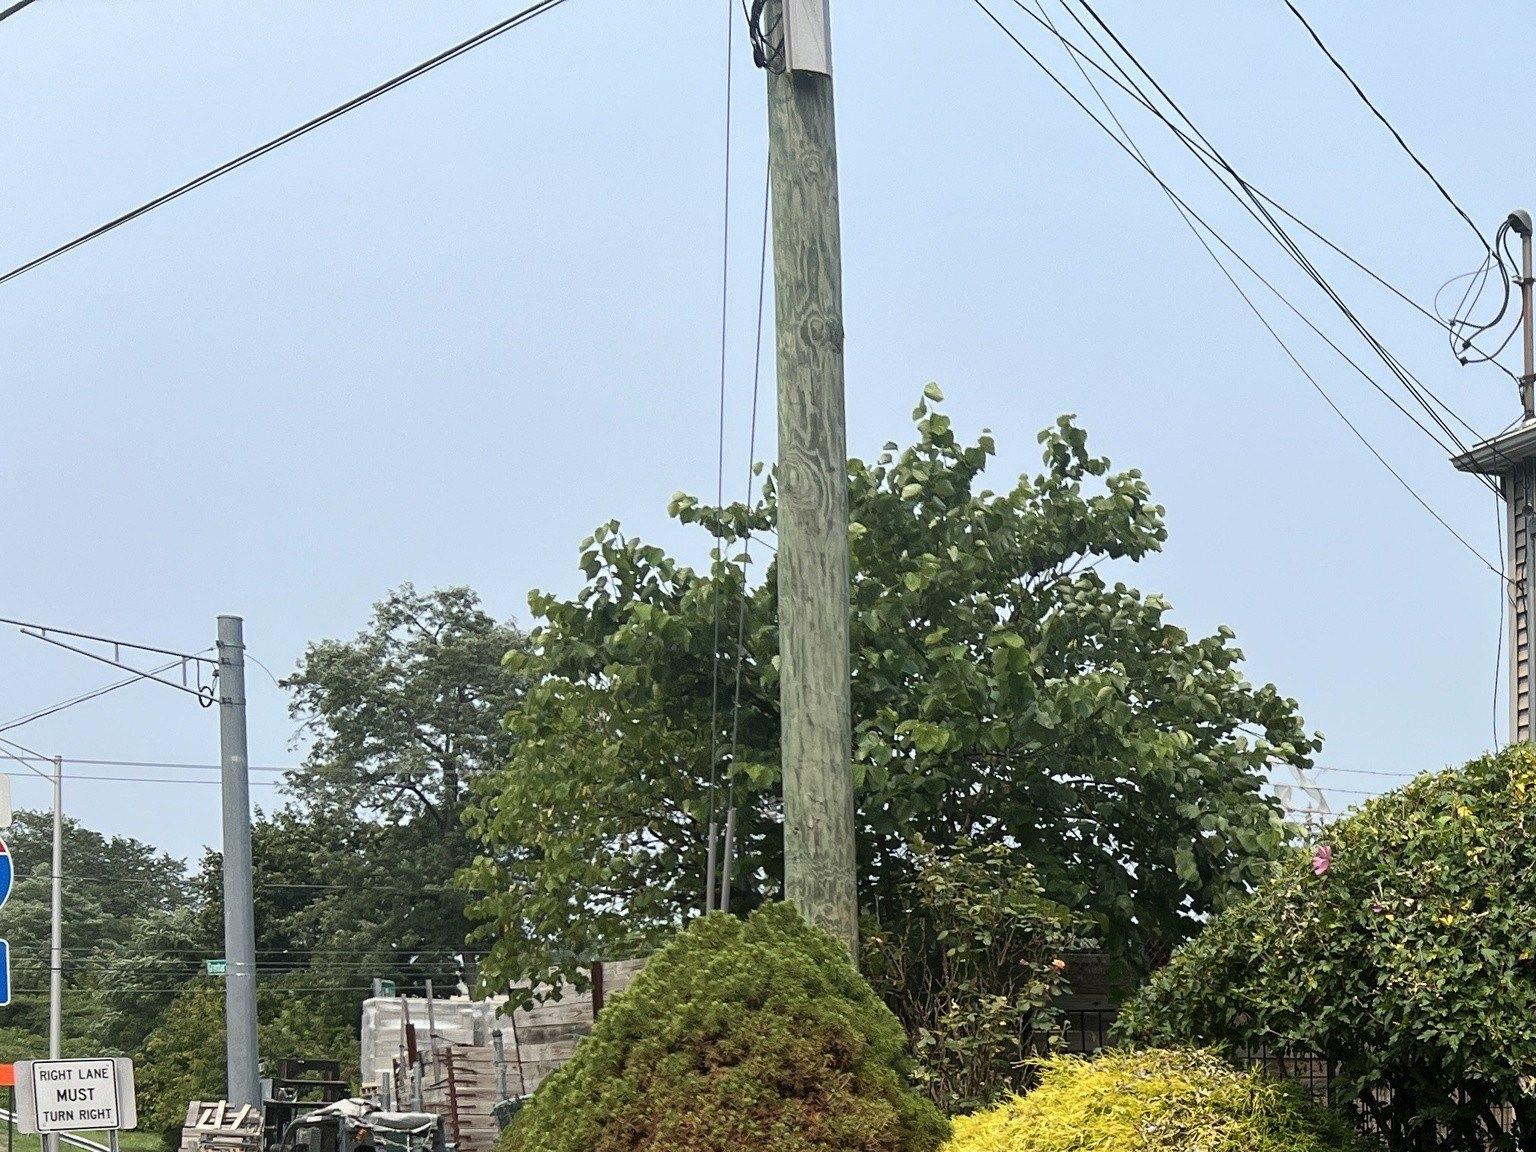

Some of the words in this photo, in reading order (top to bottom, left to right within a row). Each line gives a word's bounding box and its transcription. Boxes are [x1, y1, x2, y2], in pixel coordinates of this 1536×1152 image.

[40, 1070, 72, 1081] RIGHT
[79, 1068, 109, 1079] LANE
[57, 1088, 95, 1102] MUST
[43, 1110, 74, 1122] TURN
[80, 1108, 111, 1120] RIGHT
